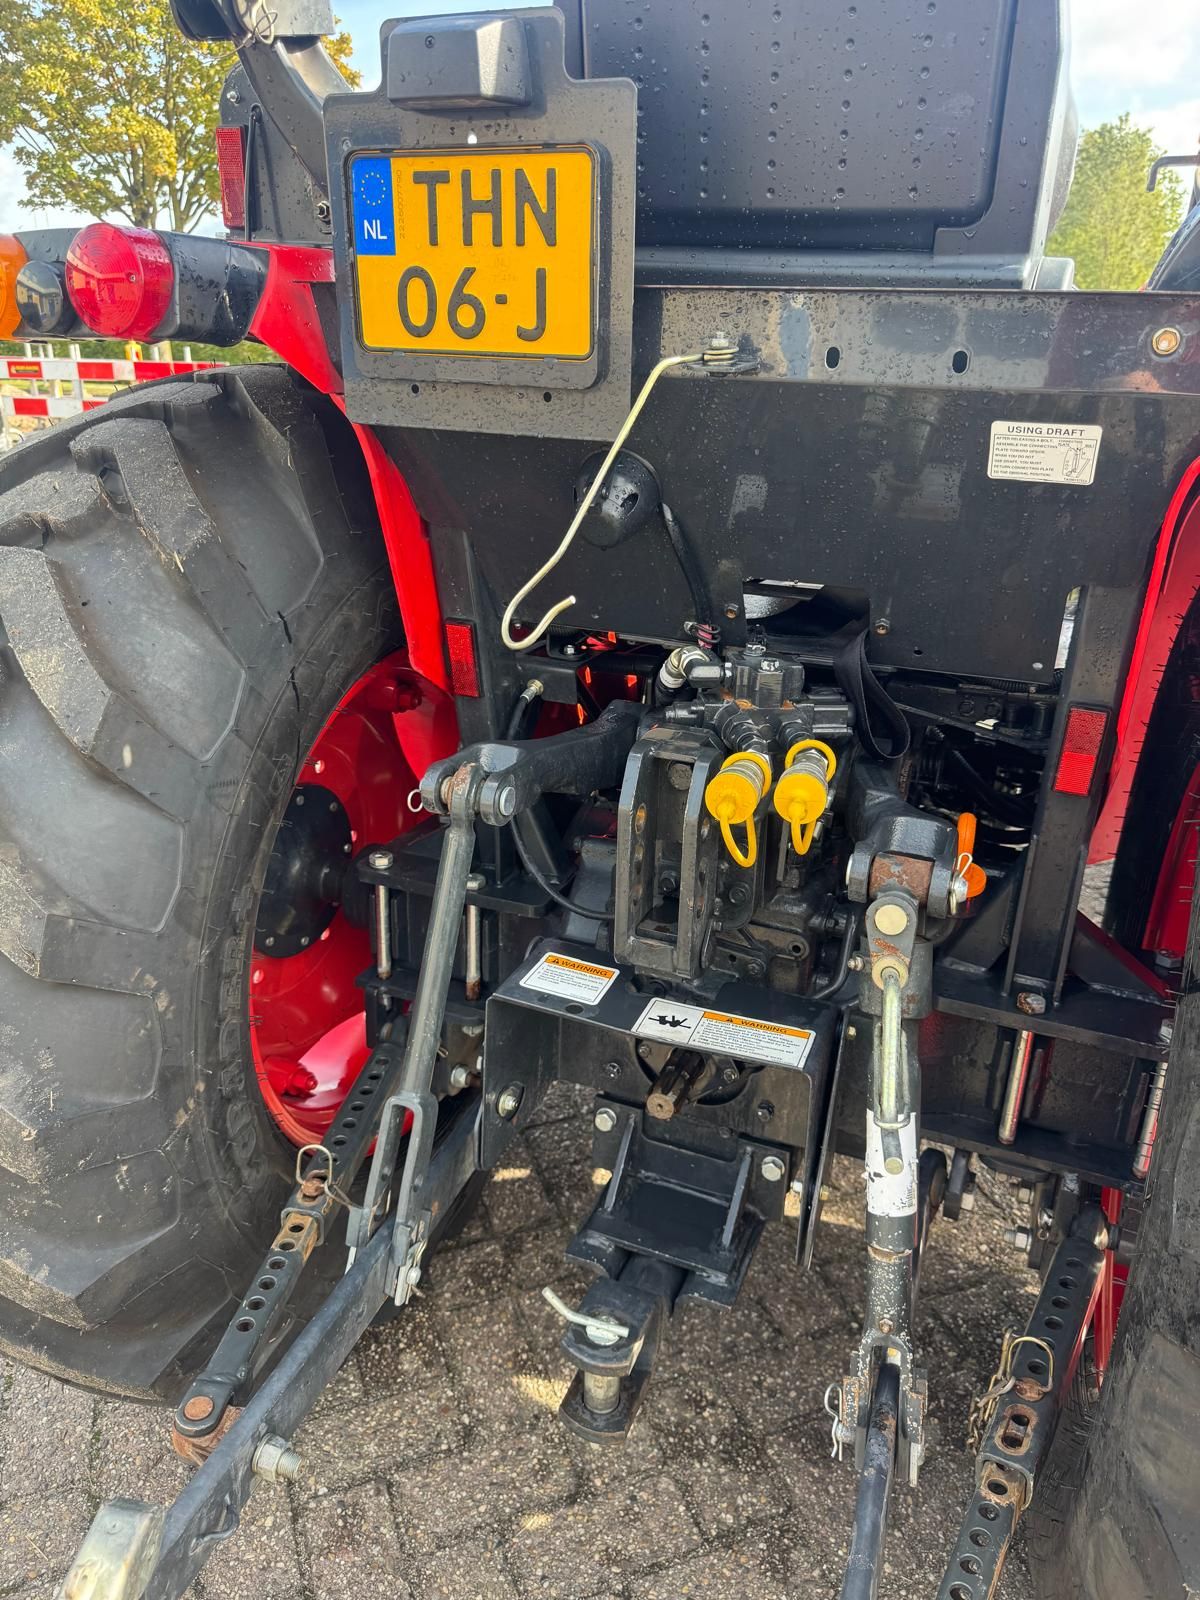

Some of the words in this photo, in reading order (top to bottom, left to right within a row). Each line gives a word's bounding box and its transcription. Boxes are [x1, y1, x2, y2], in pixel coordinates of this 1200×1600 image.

[413, 168, 557, 247] THN
[364, 219, 388, 240] NL
[1007, 425, 1043, 436] USING
[1046, 427, 1085, 437] DRAFT
[562, 960, 608, 976] WARNING
[741, 1020, 788, 1033] WARNING
